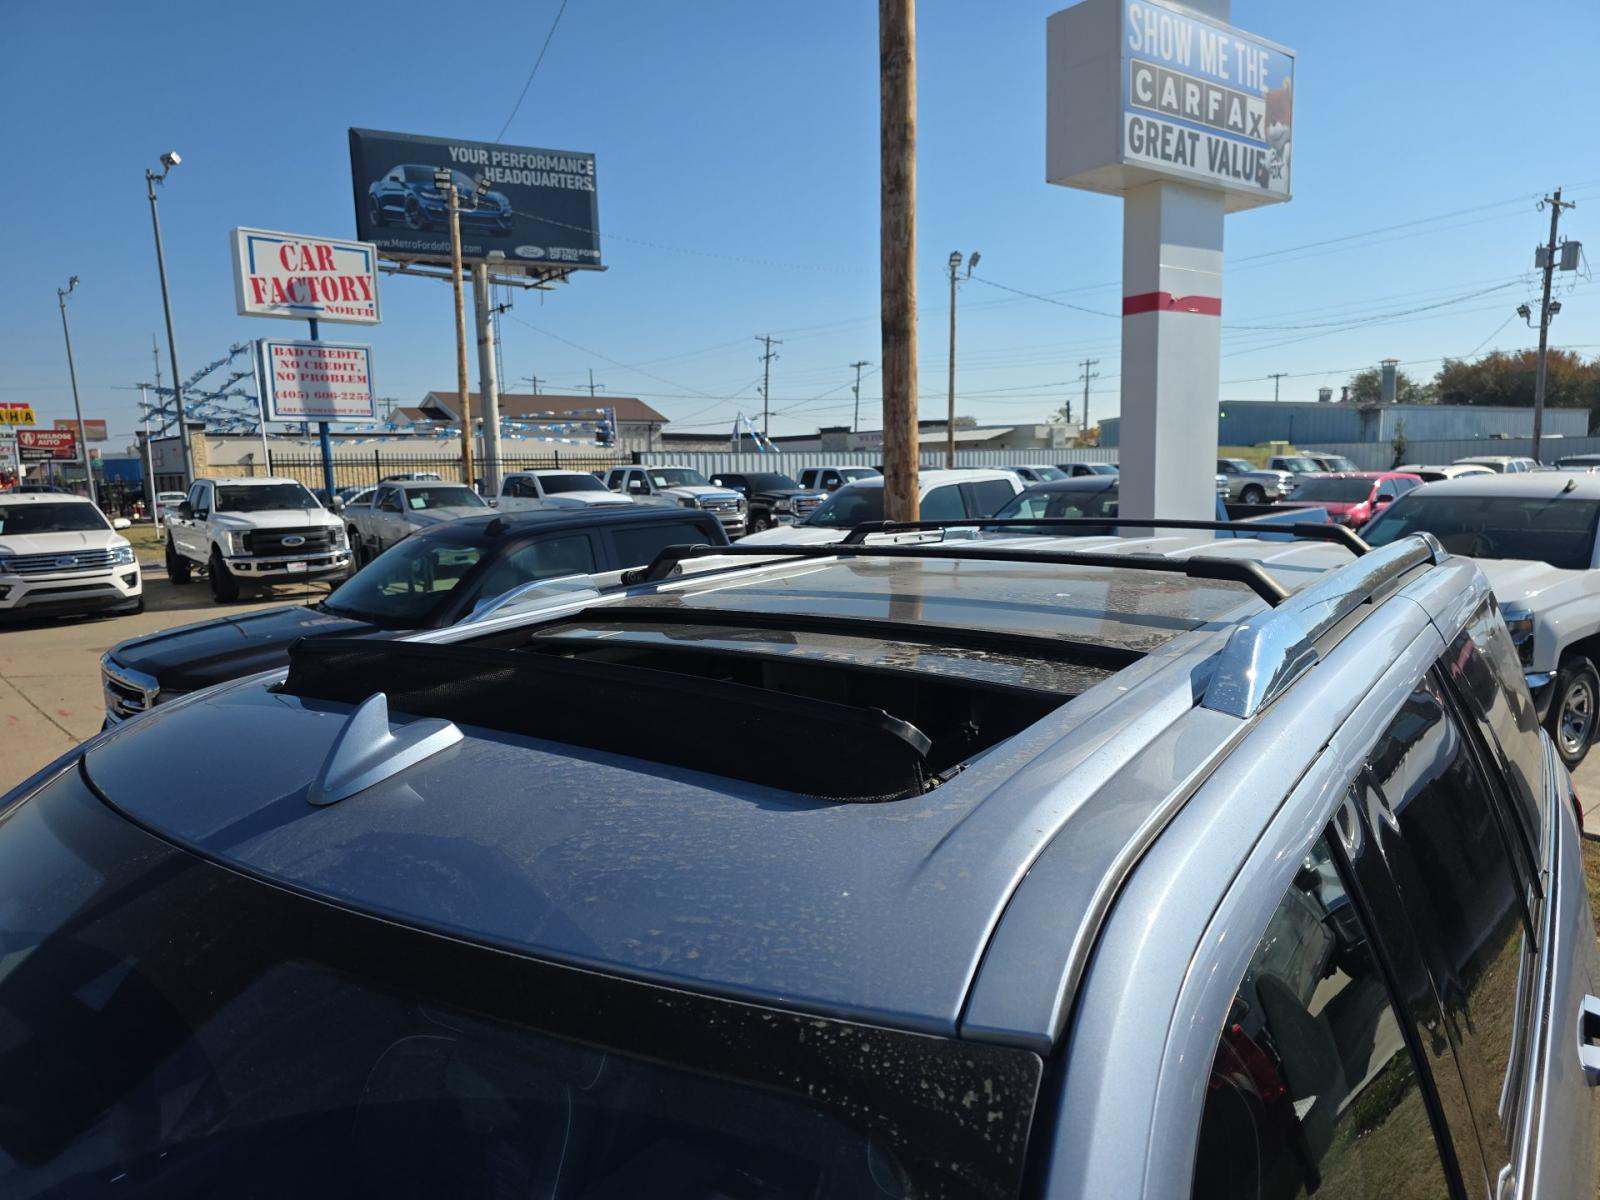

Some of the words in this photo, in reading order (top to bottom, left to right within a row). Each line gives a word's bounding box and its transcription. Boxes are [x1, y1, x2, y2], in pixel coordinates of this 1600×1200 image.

[1128, 4, 1192, 67] SHOW
[1200, 29, 1229, 80] ME
[1234, 42, 1270, 94] THE
[1136, 69, 1264, 139] CARFAX
[448, 145, 489, 165] YOUR
[492, 151, 595, 175] PERFORMANCE
[1128, 116, 1200, 168] GREAT
[1206, 136, 1266, 184] VALUE
[279, 243, 336, 272] CAR
[249, 275, 372, 305] FACTORY
[325, 305, 375, 317] NORTH
[274, 347, 304, 357] BAD
[280, 360, 300, 369] NO
[276, 372, 296, 381] NO
[300, 373, 367, 384] PROBLEM
[274, 390, 309, 400] (405)
